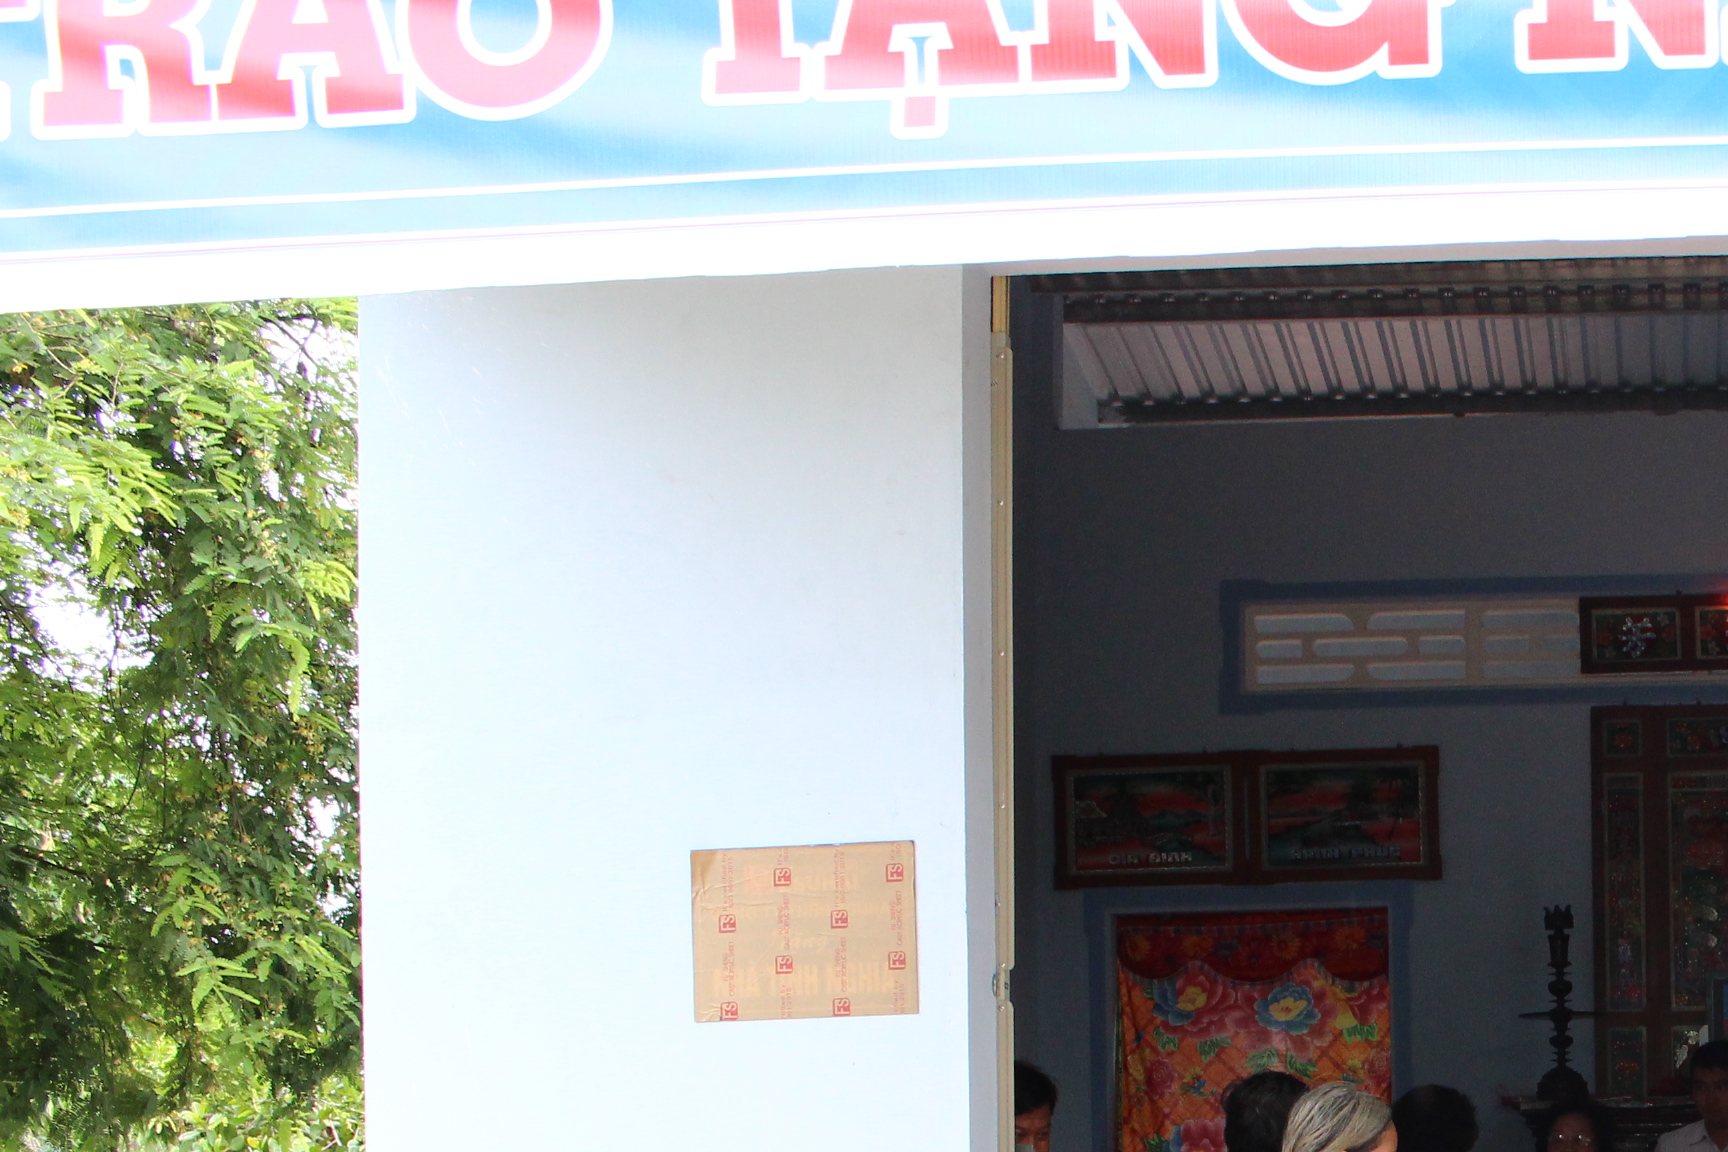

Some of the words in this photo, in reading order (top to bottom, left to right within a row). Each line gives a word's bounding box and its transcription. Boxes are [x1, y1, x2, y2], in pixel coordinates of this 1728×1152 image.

[775, 868, 791, 885] FS
[887, 864, 903, 881] FS
[720, 915, 736, 932] FS
[832, 911, 848, 927] FS
[776, 956, 792, 972] FS
[889, 952, 905, 968] FS
[722, 1002, 738, 1019] FS
[834, 999, 850, 1015] FS
